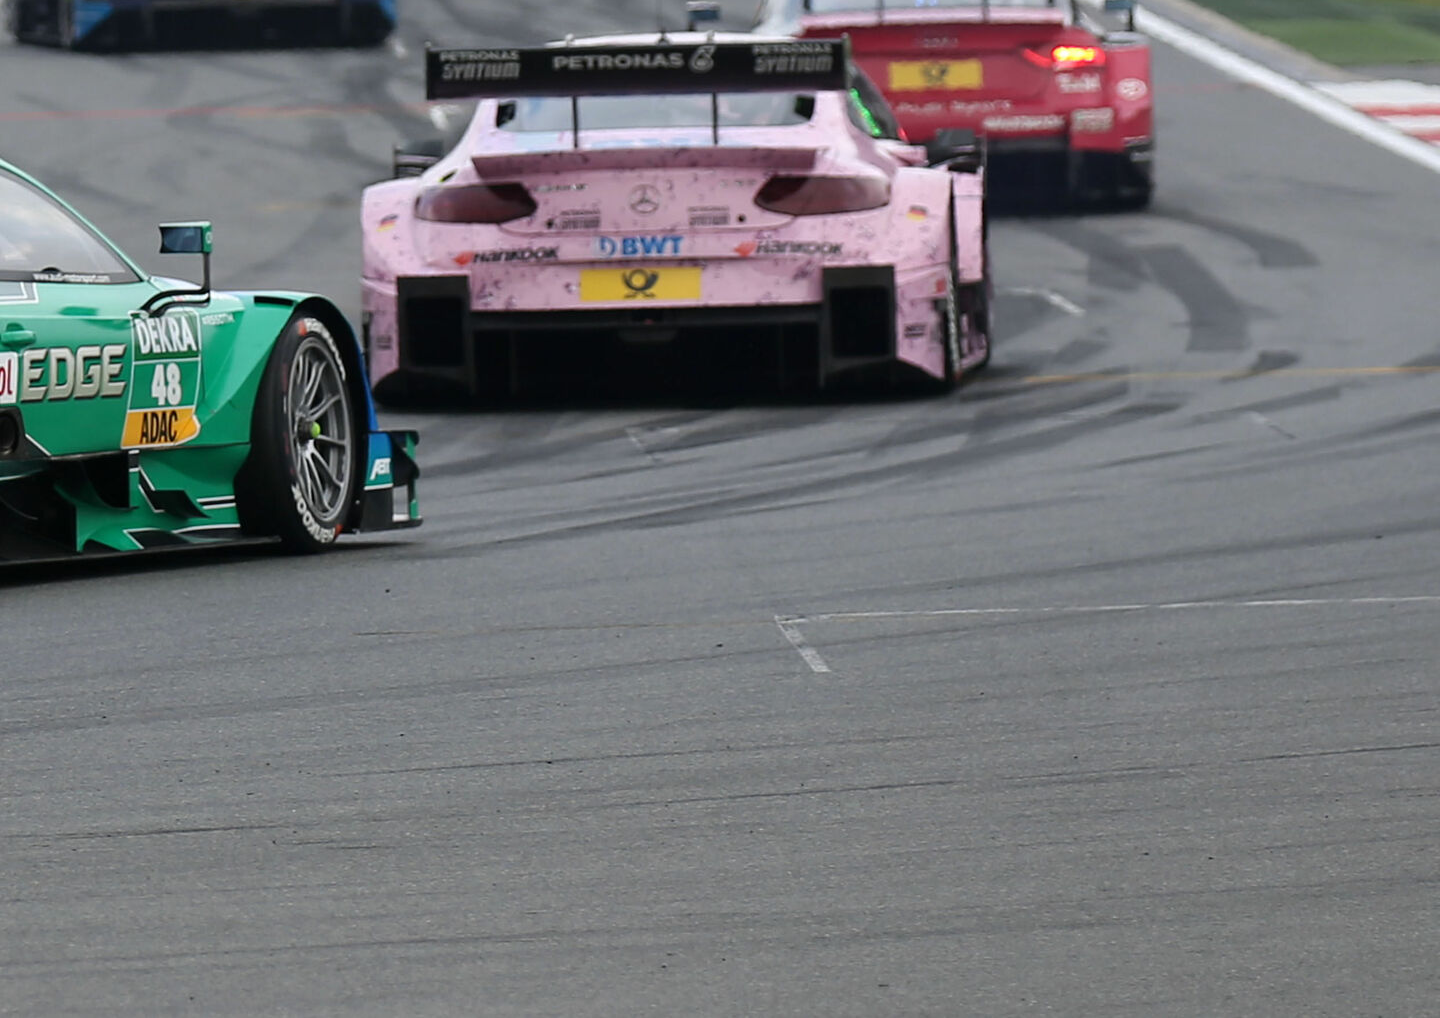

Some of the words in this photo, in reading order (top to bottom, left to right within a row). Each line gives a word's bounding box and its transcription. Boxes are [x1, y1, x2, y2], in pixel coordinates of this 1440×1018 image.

[440, 50, 520, 62] PETRONAS
[552, 53, 684, 71] PETRONAS
[622, 236, 684, 256] BWT
[135, 315, 198, 355] DEKRA
[20, 344, 127, 403] EDGE
[151, 362, 183, 406] 48
[139, 409, 179, 445] ADAC
[370, 457, 392, 481] ABT
